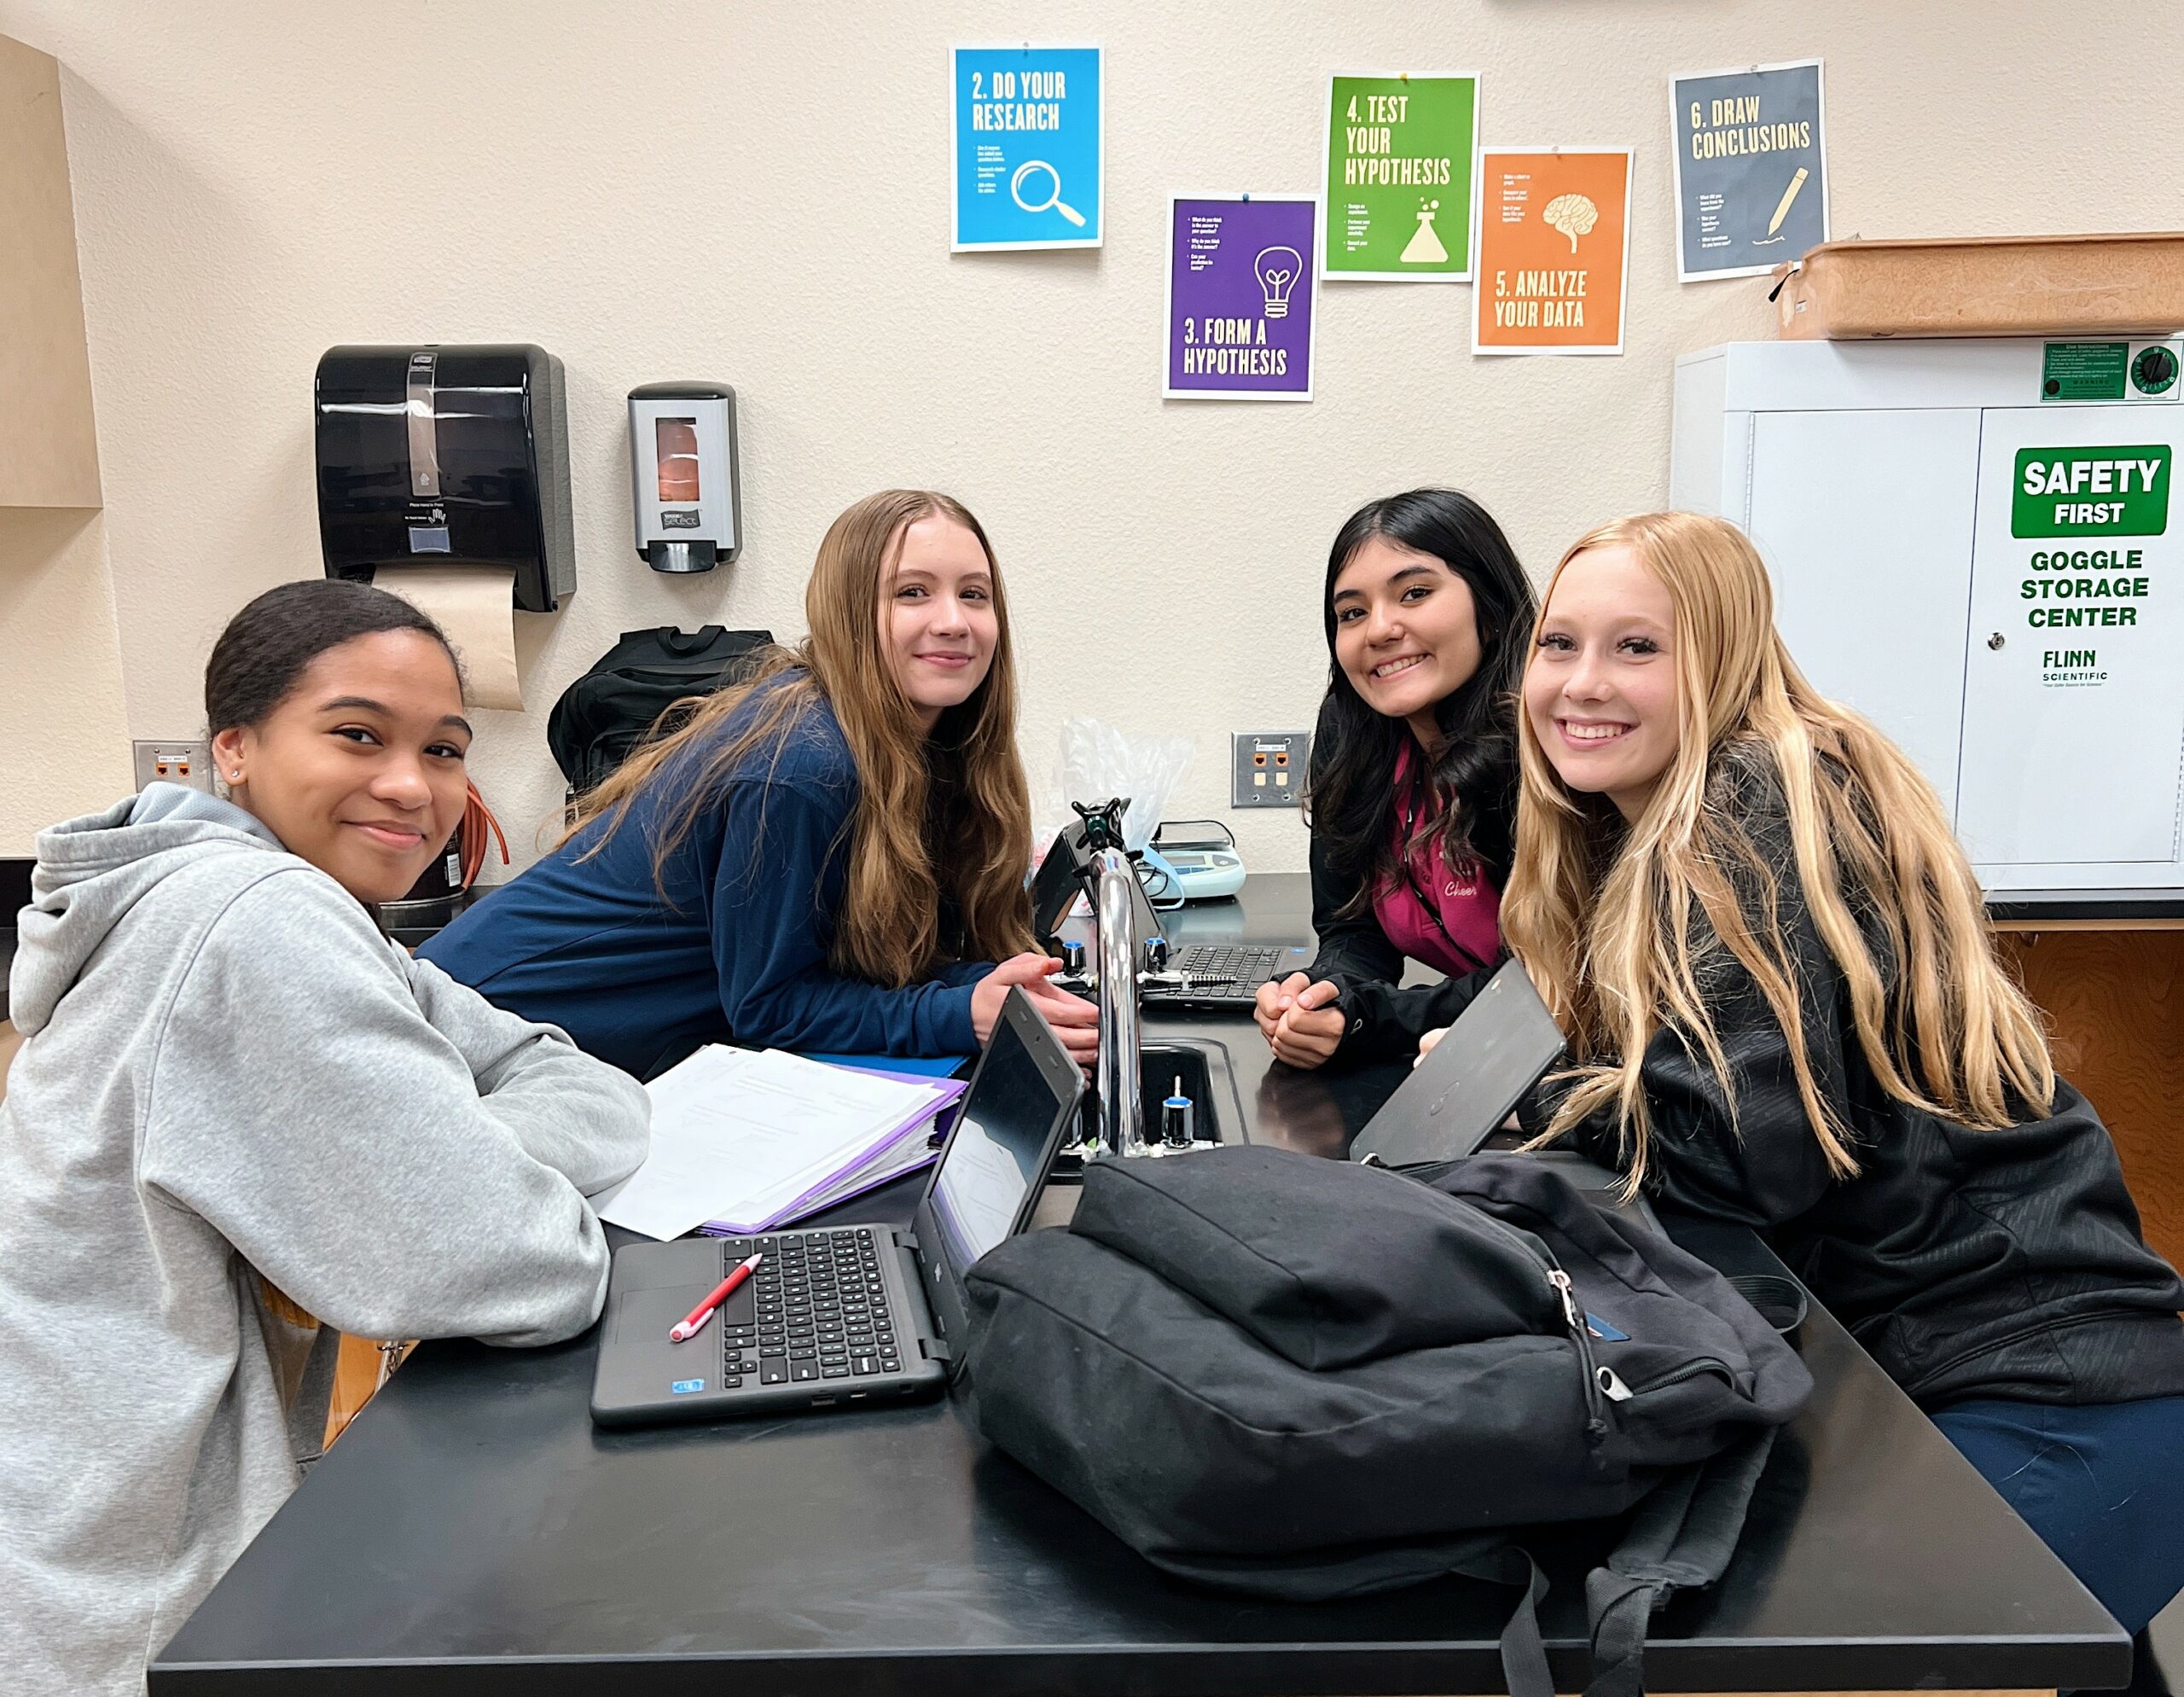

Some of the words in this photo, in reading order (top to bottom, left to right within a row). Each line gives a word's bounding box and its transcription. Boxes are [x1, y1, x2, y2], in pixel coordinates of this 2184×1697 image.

[973, 72, 987, 99] 2.
[993, 72, 1015, 99] DO
[1020, 72, 1066, 99] YOUR
[973, 103, 1060, 131] RESEARCH
[1346, 96, 1362, 123] 4.
[1368, 96, 1409, 123] TEST
[1690, 102, 1706, 129] 6.
[1711, 96, 1760, 126] DRAW
[1346, 127, 1391, 154] YOUR
[1692, 121, 1810, 160] CONCLUSIONS
[1345, 158, 1451, 185] HYPOTHESIS
[1496, 270, 1510, 297] 5.
[1515, 270, 1588, 297] ANALYZE
[1496, 301, 1538, 327] YOUR
[1543, 301, 1583, 327] DATA
[1184, 317, 1199, 345] 3.
[1205, 318, 1251, 345] FORM
[1256, 319, 1266, 345] A
[1184, 348, 1287, 375] HYPOTHESIS
[2024, 459, 2161, 495] SAFETY
[2054, 503, 2125, 525] FIRST
[2030, 549, 2143, 571] GOGGLE
[2020, 578, 2150, 599] STORAGE
[2028, 607, 2137, 628] CENTER
[2043, 650, 2096, 668] FLINN
[2042, 672, 2108, 681] SCIENTIFIC
[1444, 881, 1477, 897] Cheer
